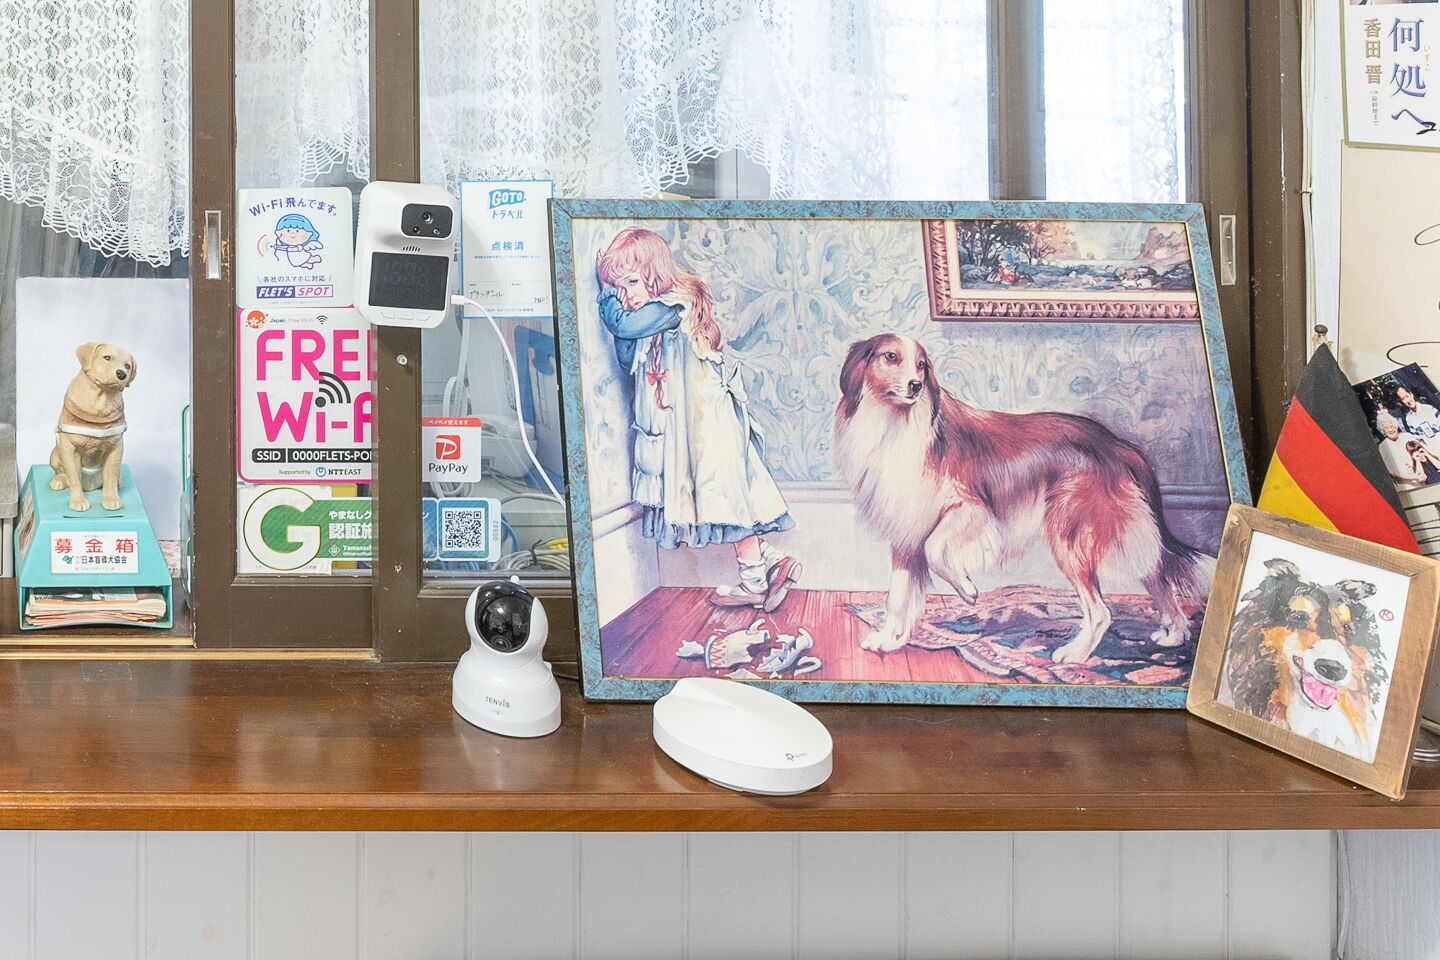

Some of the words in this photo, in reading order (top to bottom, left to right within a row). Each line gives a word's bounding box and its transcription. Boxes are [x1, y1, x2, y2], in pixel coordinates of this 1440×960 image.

[492, 209, 524, 220] トラベル
[258, 287, 294, 298] FLET'S
[297, 286, 330, 296] SPOT
[256, 330, 372, 381] FRE
[256, 449, 281, 462] SSID
[292, 449, 372, 462] 0000FLETS-PO
[428, 463, 469, 474] PayPay
[55, 538, 134, 554] 募金箱
